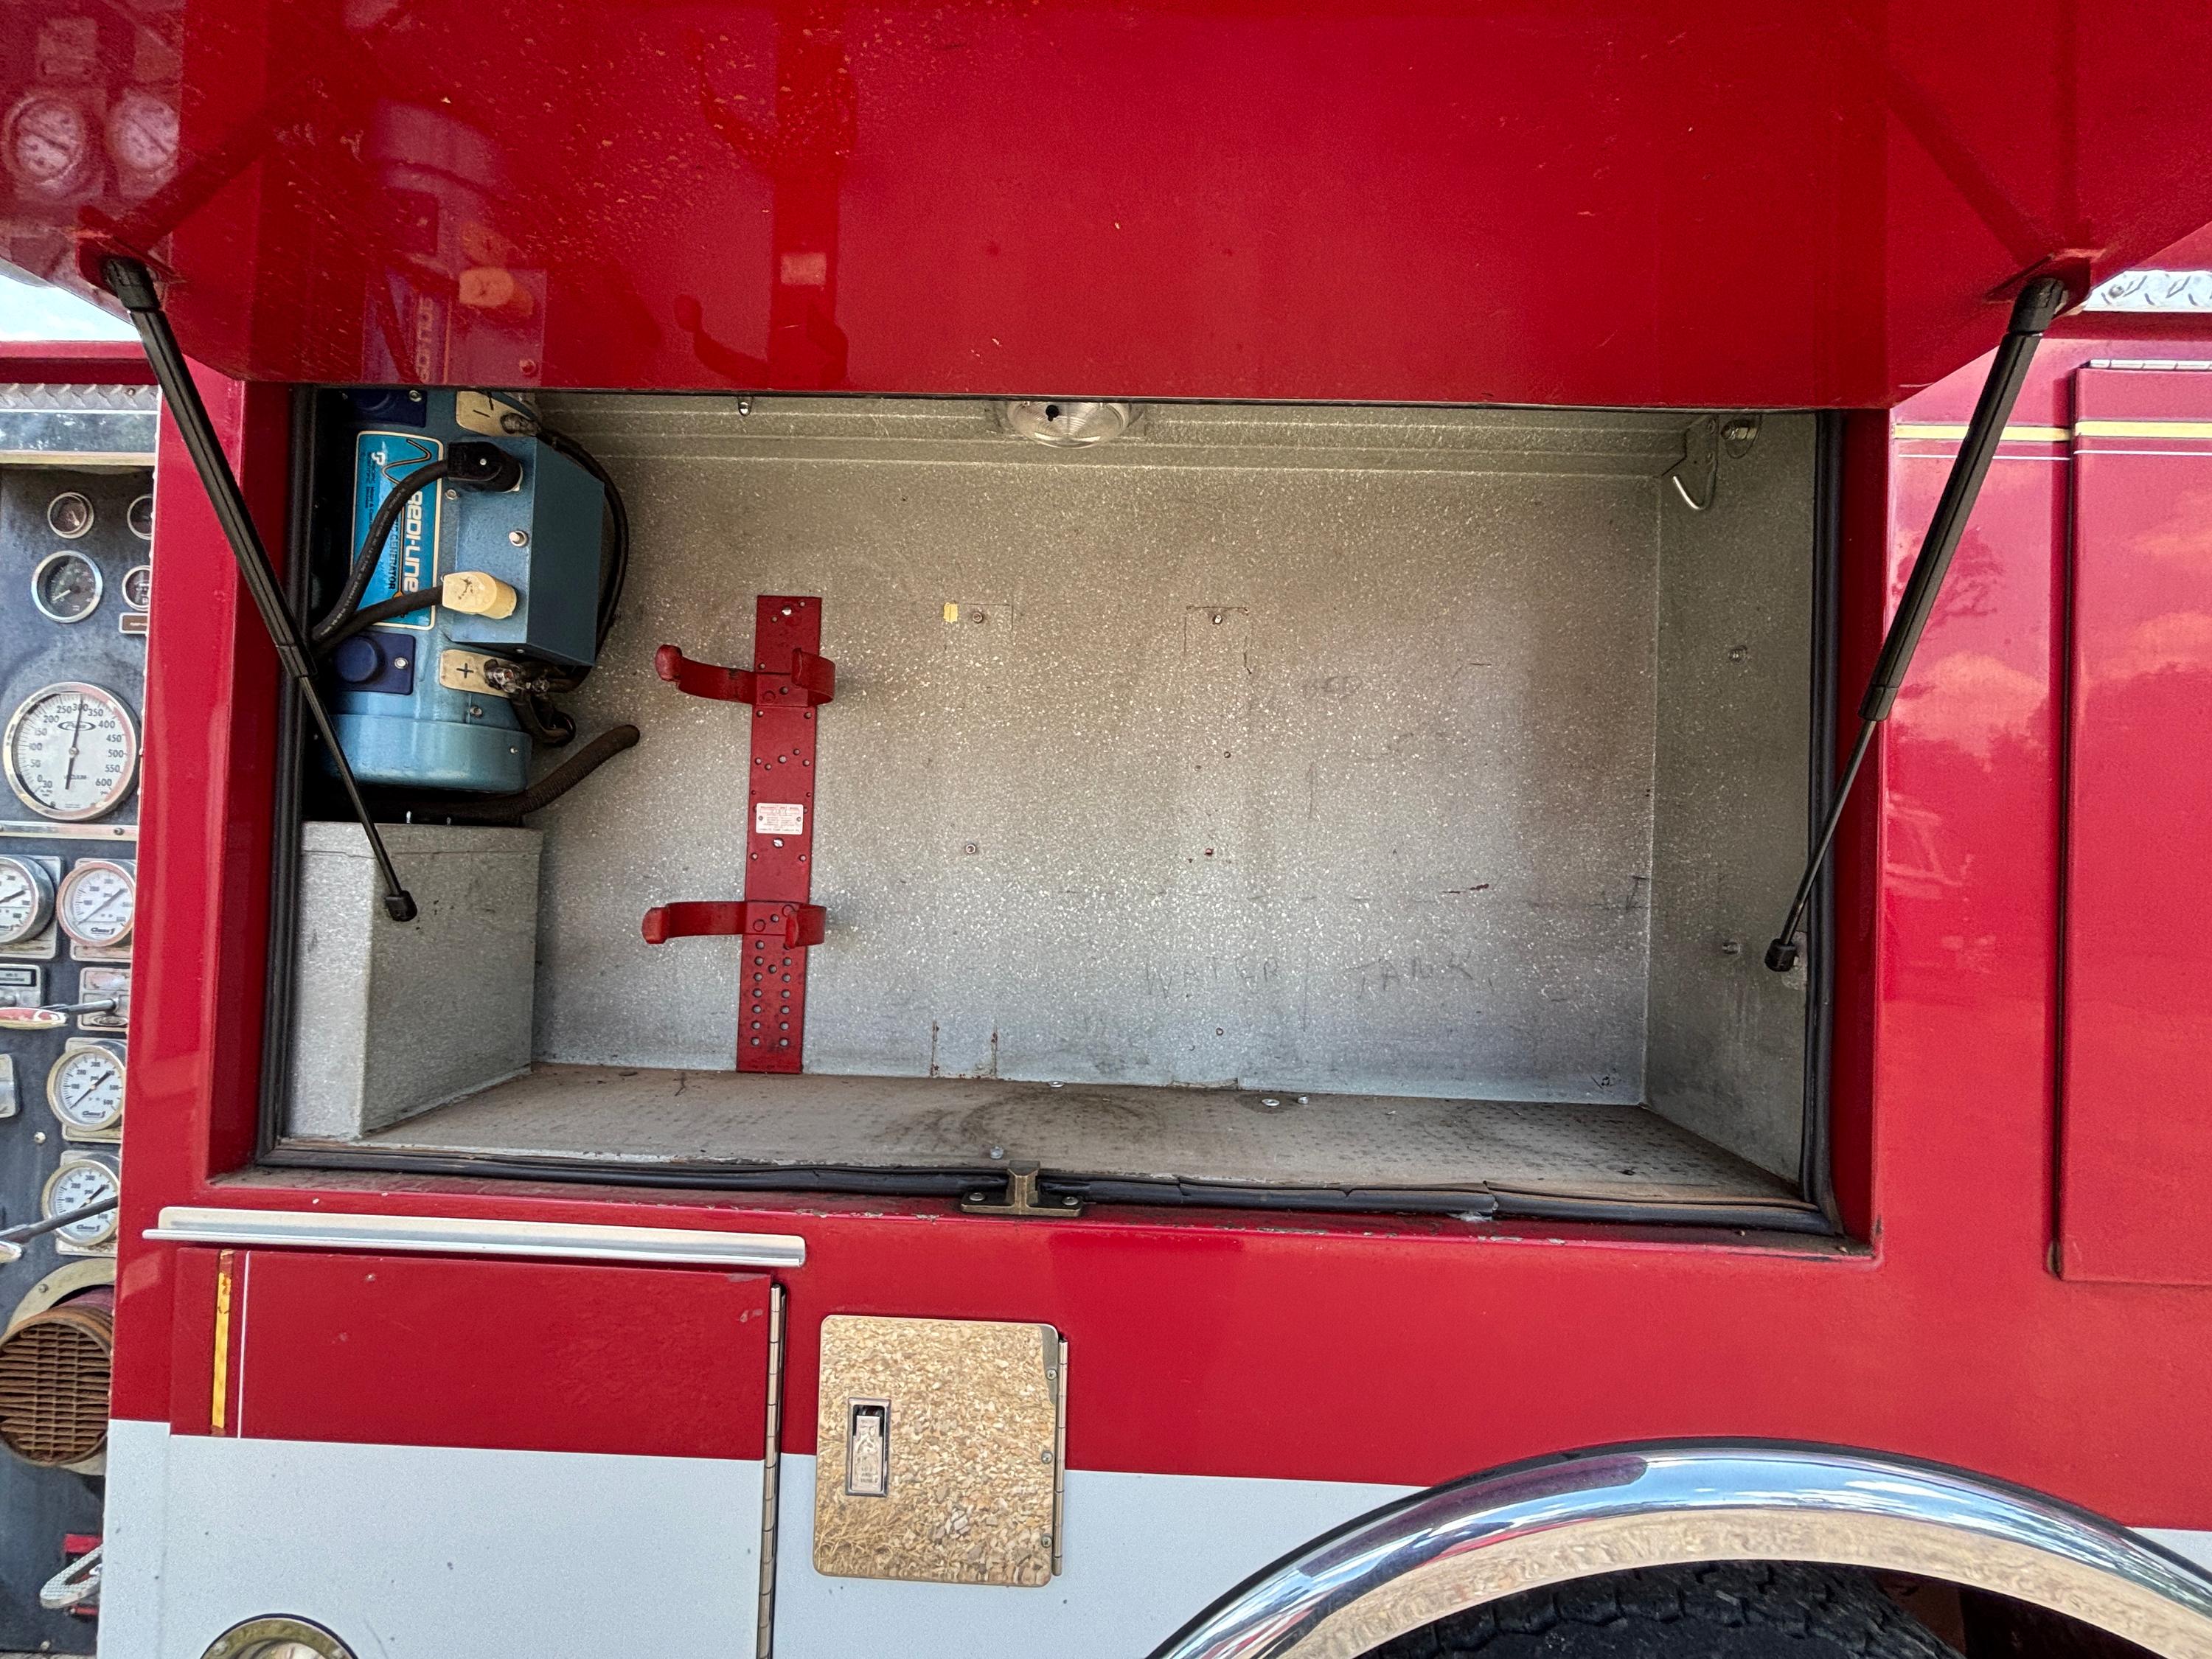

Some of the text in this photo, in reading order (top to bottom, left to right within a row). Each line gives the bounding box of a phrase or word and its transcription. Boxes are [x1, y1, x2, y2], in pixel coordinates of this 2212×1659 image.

[388, 534, 397, 591] GENERATOR
[57, 705, 72, 714] 250
[88, 708, 104, 717] 350
[44, 714, 60, 723] 200
[98, 720, 116, 729] 400
[106, 734, 122, 742] 450
[29, 742, 43, 751] 100
[108, 749, 124, 758] 500
[30, 759, 41, 768] 50
[105, 764, 121, 773] 550
[43, 780, 53, 789] 30
[95, 778, 113, 787] 600
